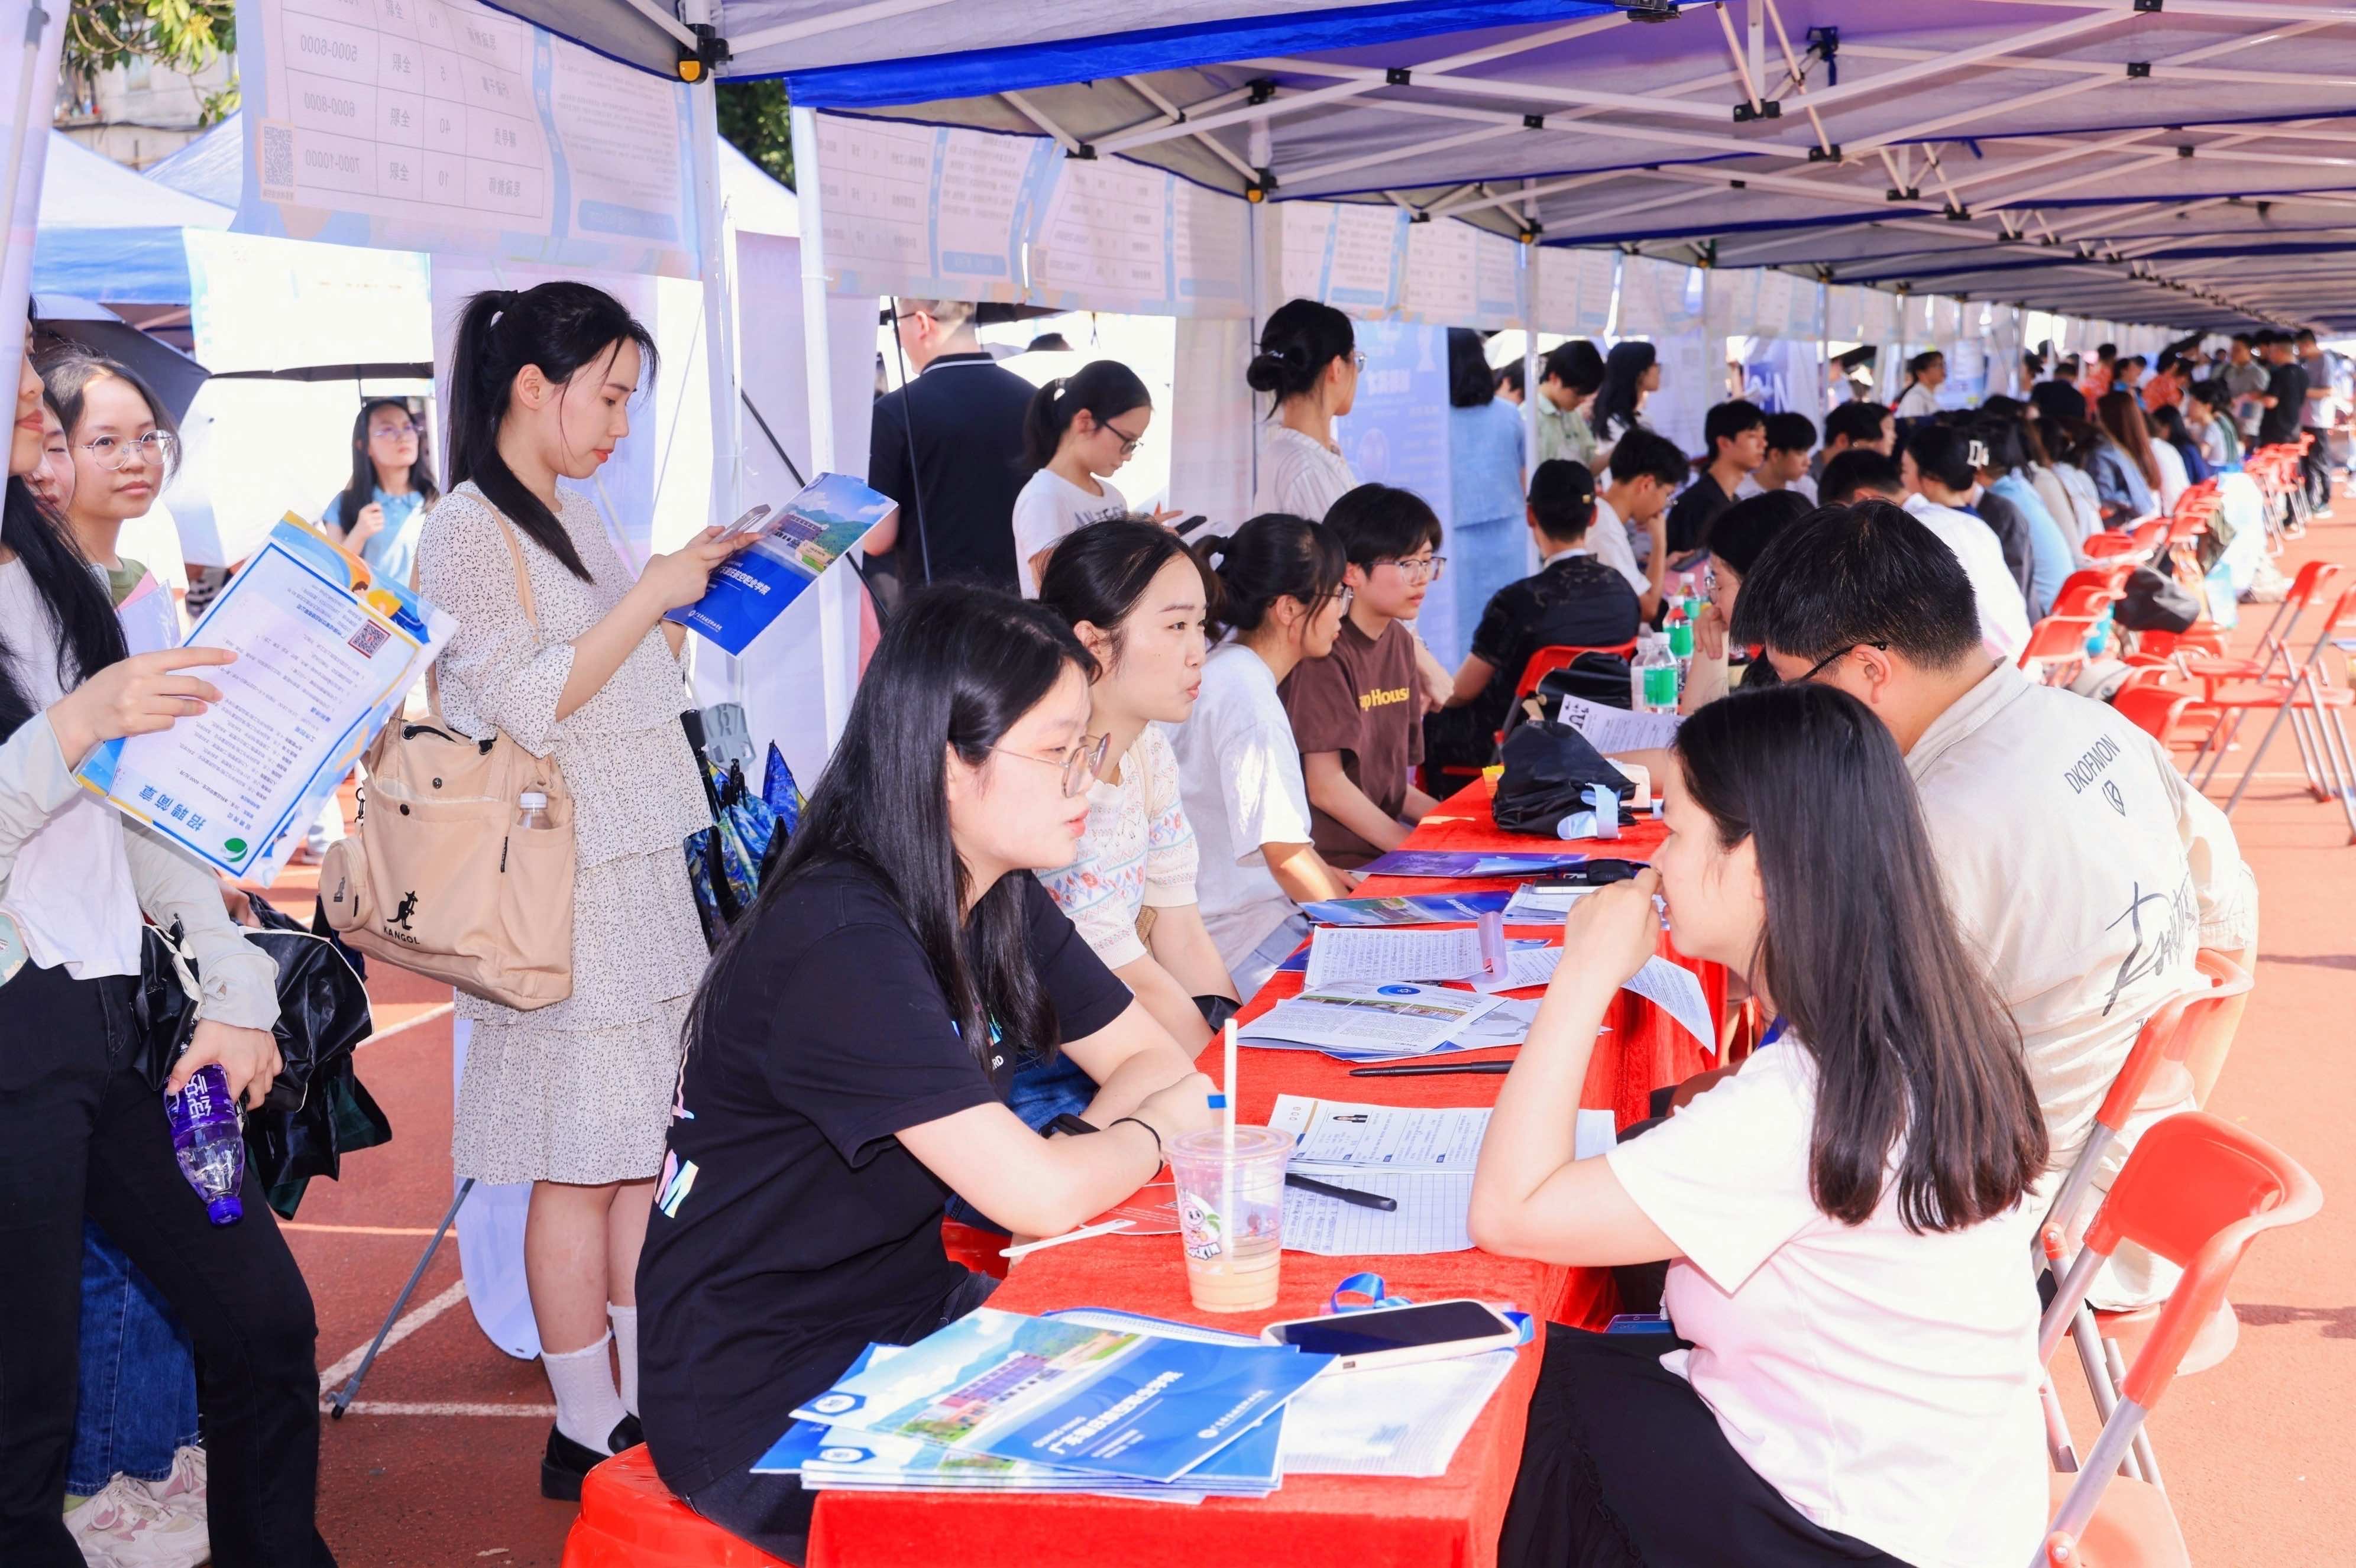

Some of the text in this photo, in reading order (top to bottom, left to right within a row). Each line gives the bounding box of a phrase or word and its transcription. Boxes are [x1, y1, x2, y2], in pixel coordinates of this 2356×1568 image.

[2064, 734, 2121, 794] DKOFMON
[138, 783, 208, 832] 招聘简章
[384, 927, 420, 945] KANGOL
[184, 1074, 212, 1119] 纯悦
